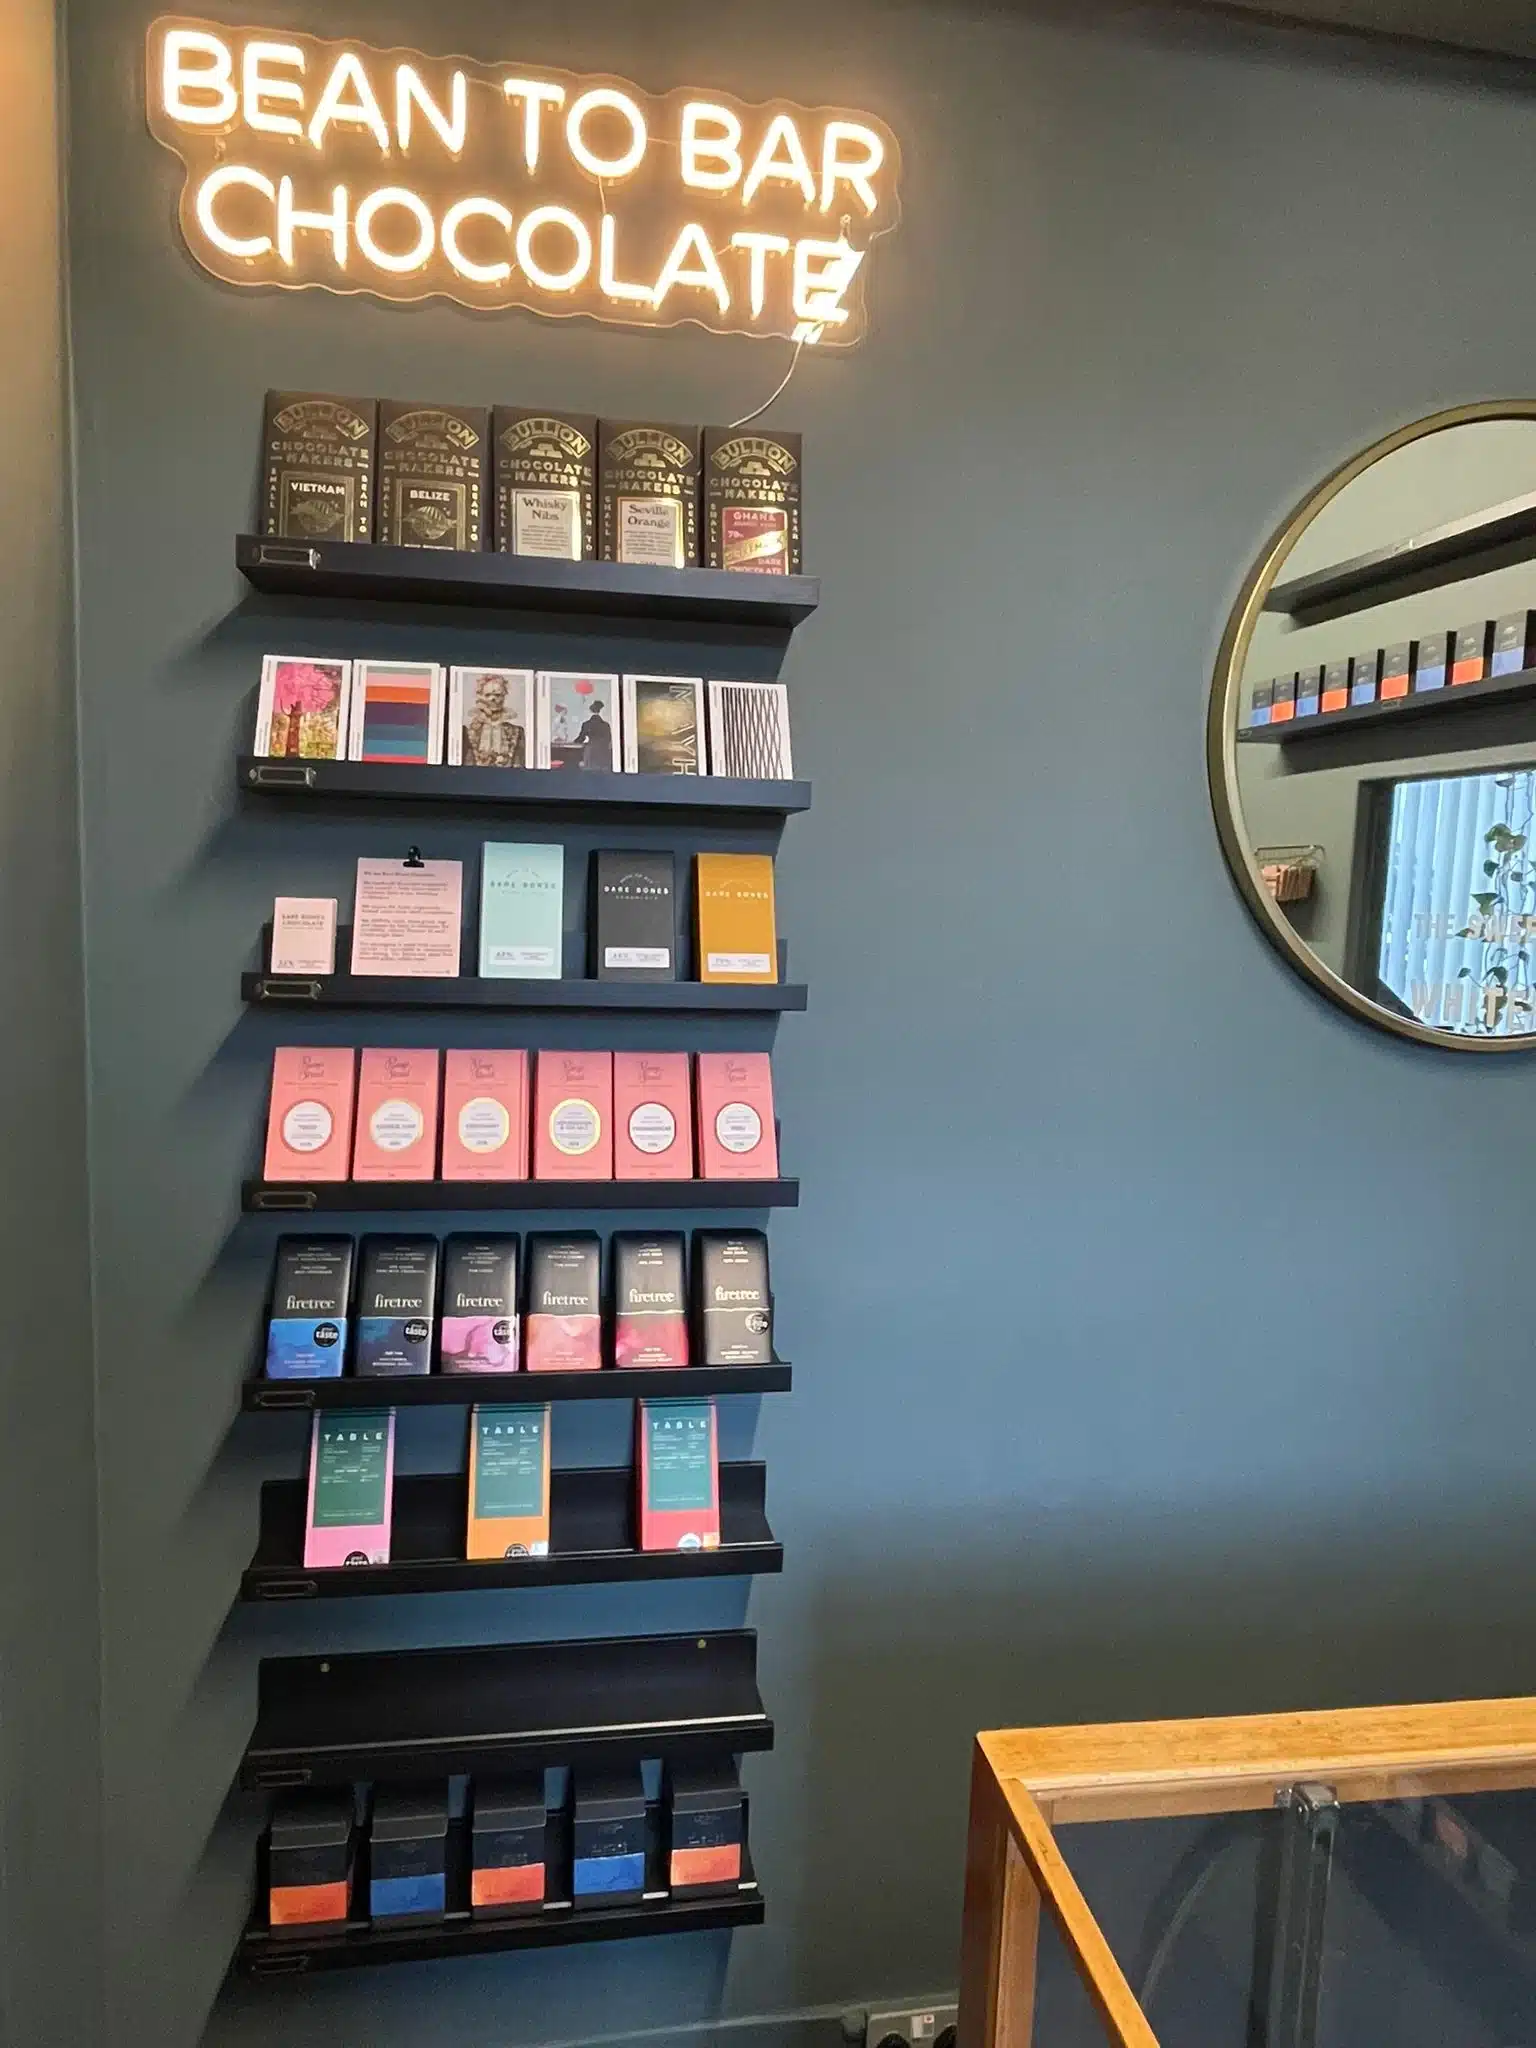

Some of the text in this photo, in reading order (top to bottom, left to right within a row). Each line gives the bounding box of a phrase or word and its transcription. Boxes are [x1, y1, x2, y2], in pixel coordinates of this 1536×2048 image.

[162, 30, 884, 215] BEAN TO BAR
[196, 165, 856, 328] CHOCOLATE
[507, 419, 587, 458] BULLION
[272, 441, 369, 459] CHOCOLATE
[612, 431, 689, 466] BULLION
[714, 438, 796, 474] BULLION
[285, 453, 353, 468] MAKERS
[500, 459, 592, 478] CHOCOLATE
[514, 471, 579, 488] MAKERS
[604, 469, 694, 485] CHOCOLATE
[290, 482, 346, 496] VIETNAM
[619, 481, 681, 496] MAKERS
[710, 477, 799, 493] CHOCOLATE
[409, 490, 451, 502] BELIZE
[724, 489, 785, 503] MAKERS
[523, 497, 568, 512] Whisky
[628, 504, 670, 517] Seville
[531, 510, 560, 521] Nibs
[627, 516, 671, 528] Orange
[732, 511, 777, 522] GHANA
[359, 517, 367, 534] TO
[470, 524, 478, 541] TO
[1414, 912, 1457, 939] THE
[456, 1292, 504, 1307] firetree
[543, 1290, 589, 1306] firetree
[629, 1288, 676, 1303] firetree
[715, 1284, 761, 1301] firetree
[286, 1295, 336, 1310] firetree
[374, 1294, 423, 1309] firetree
[482, 1425, 540, 1435] TABLE
[652, 1420, 707, 1430] TABLE
[323, 1432, 383, 1442] TABLE
